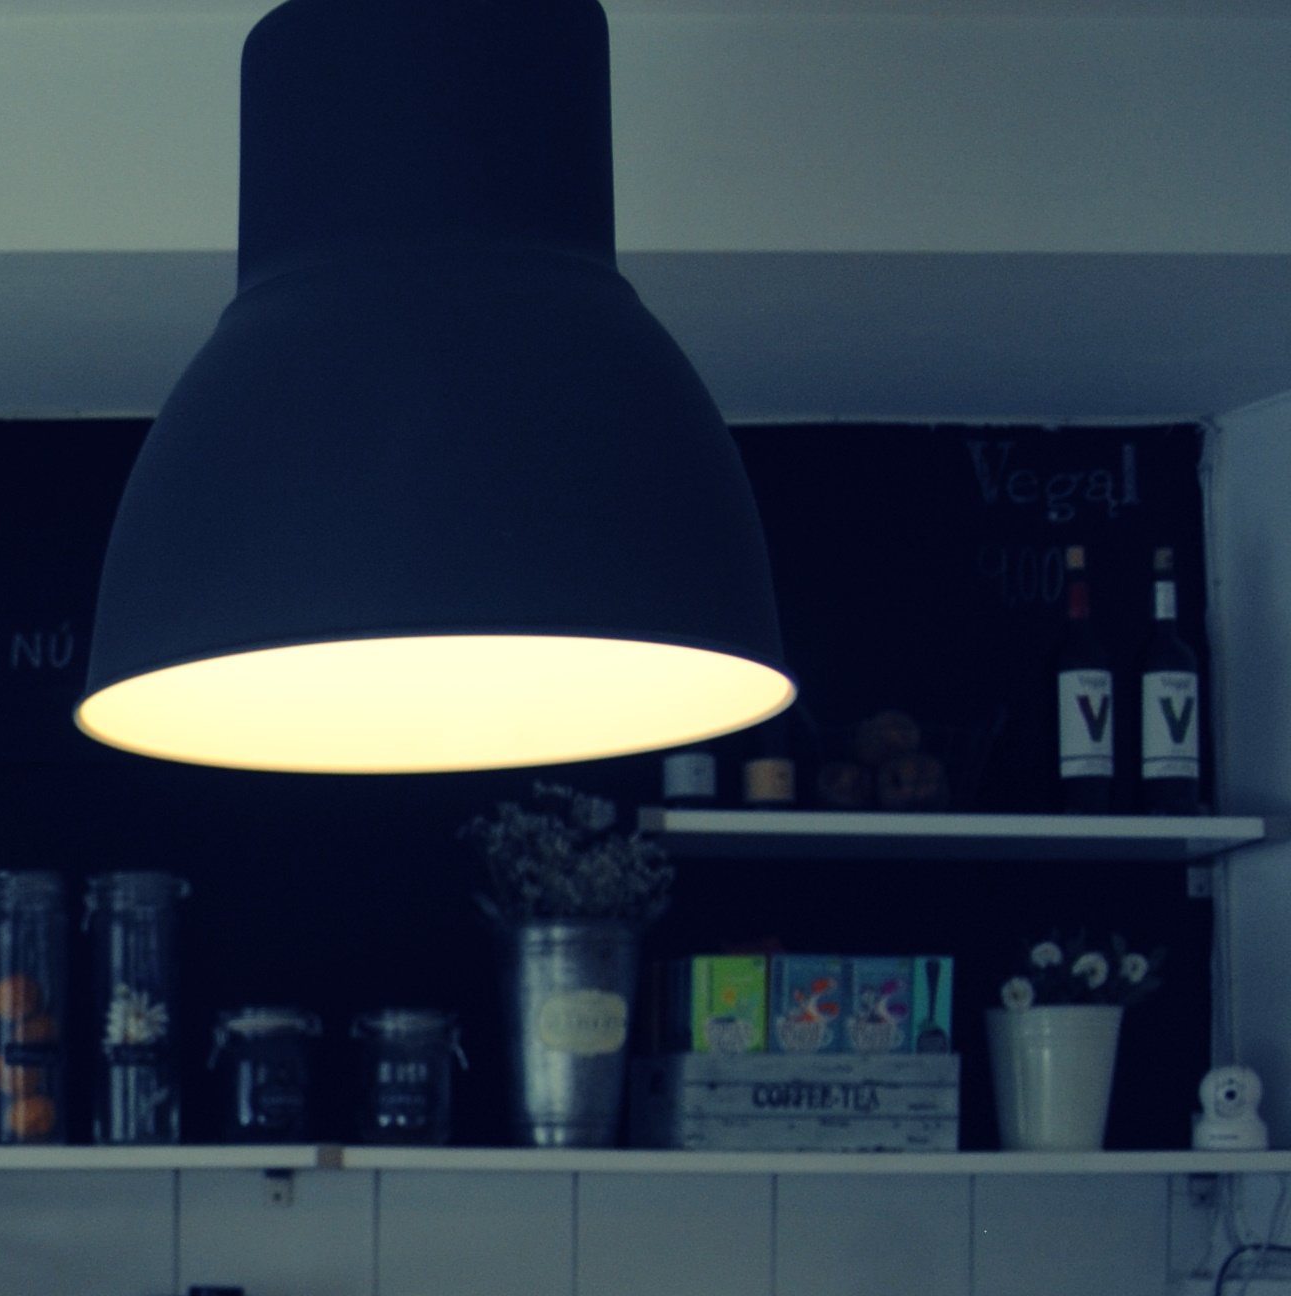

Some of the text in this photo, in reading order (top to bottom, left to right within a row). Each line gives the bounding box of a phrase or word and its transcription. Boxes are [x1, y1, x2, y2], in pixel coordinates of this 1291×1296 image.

[967, 438, 1139, 523] Vegal
[1077, 694, 1111, 742] V
[1159, 696, 1195, 744] V
